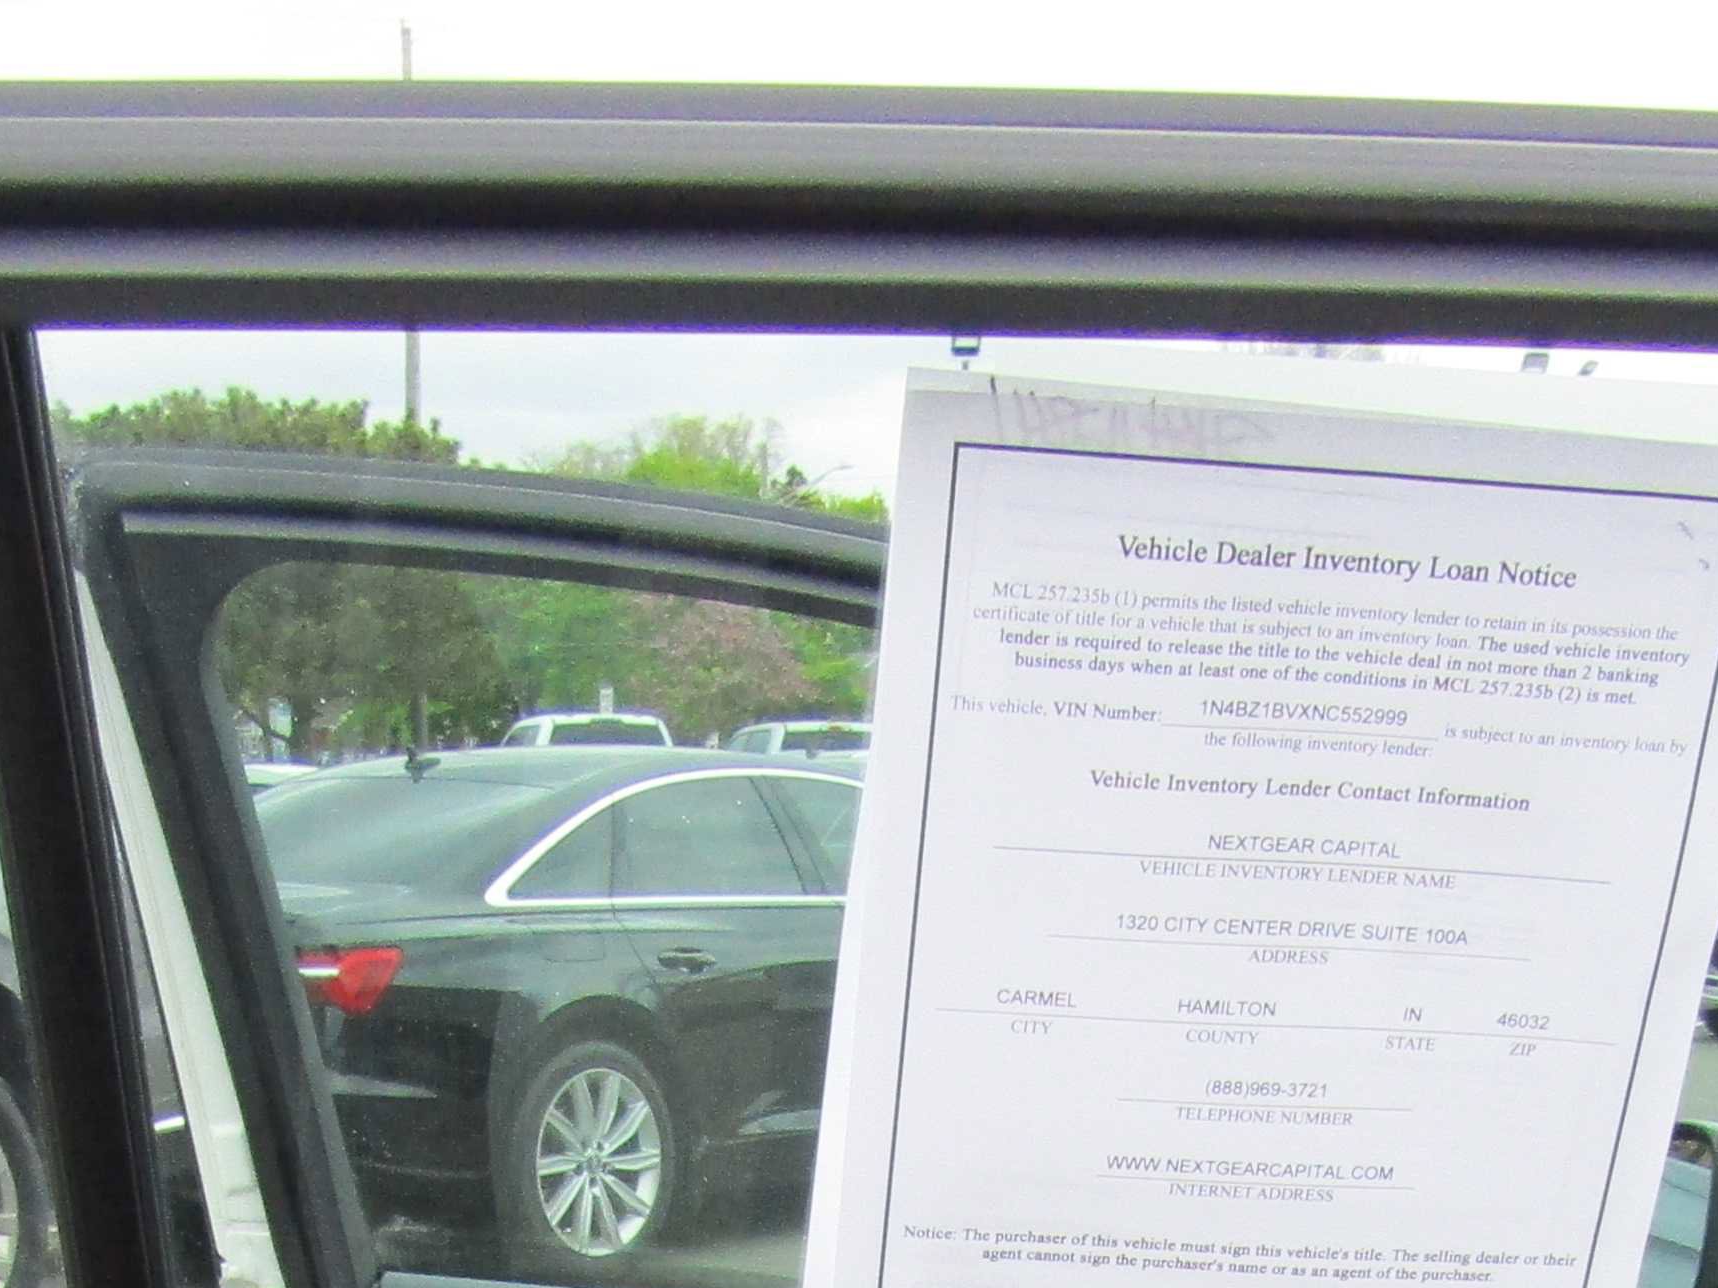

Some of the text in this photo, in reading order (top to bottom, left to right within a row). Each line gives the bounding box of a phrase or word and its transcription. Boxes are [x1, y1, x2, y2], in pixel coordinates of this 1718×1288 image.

[1119, 535, 1577, 588] Vehicle Dealer Inventory Loan Notice
[992, 582, 1034, 599] MCL
[1114, 590, 1139, 609] (1)
[1141, 594, 1199, 610] permits
[1203, 595, 1227, 611] the
[1231, 597, 1273, 614] listed
[1274, 601, 1332, 617] vehicle
[1334, 603, 1409, 626] inventory
[1411, 608, 1461, 626] lender
[1464, 614, 1480, 627] to
[1482, 615, 1528, 631] retain
[1530, 617, 1547, 632] in
[1549, 618, 1568, 634] its
[1571, 624, 1651, 640] possession
[1655, 627, 1679, 643] the
[973, 606, 1051, 623] certificate
[1054, 609, 1072, 624] of
[1075, 610, 1105, 626] title
[1110, 612, 1133, 627] for
[1136, 617, 1145, 628] a
[1151, 615, 1204, 632] vehicle
[1209, 618, 1241, 634] that
[1241, 619, 1256, 635] is
[1258, 622, 1312, 638] subject
[1317, 626, 1333, 640] to
[1335, 630, 1355, 641] an
[1357, 627, 1432, 650] inventory
[1475, 635, 1508, 651] The
[1513, 639, 1551, 654] used
[1553, 641, 1611, 659] vehicle
[1615, 645, 1690, 668] inventory
[999, 629, 1659, 689] lender is required to release the title to the vehicle deal in not more than 2 banking
[1015, 652, 1083, 670] business
[1088, 655, 1125, 675] days
[1130, 658, 1173, 674] when
[1178, 663, 1193, 675] at
[1198, 661, 1235, 678] least
[1239, 668, 1269, 680] one
[1273, 666, 1293, 681] of
[1295, 667, 1319, 683] the
[1323, 670, 1407, 688] conditions
[1411, 674, 1428, 690] in
[1432, 676, 1474, 693] MCL
[1557, 685, 1582, 704] (2)
[1586, 687, 1600, 703] is
[951, 696, 983, 712] This
[1053, 701, 1088, 717] VIN
[1202, 700, 1408, 726] 1N4BZ1BVXNC552999
[1204, 730, 1227, 746] the
[1232, 731, 1303, 753] following
[1307, 735, 1379, 757] inventory
[1091, 770, 1530, 811] Vehicle Inventory Lender Contact Information
[1208, 835, 1400, 858] NEXTGEAR CAPITAL
[1140, 861, 1456, 890] VEHICLE INVENTORY LENDER NAME
[1118, 915, 1468, 945] 1320 CITY CENTER DRIVE SUITE 100A
[1248, 948, 1329, 965] ADDRESS
[997, 989, 1076, 1009] CARMEL
[1178, 999, 1277, 1017] HAMILTON
[1010, 1018, 1053, 1034] CITY
[1403, 1008, 1422, 1022] IN
[1496, 1012, 1550, 1031] 46032
[1185, 1028, 1259, 1044] COUNTY
[1385, 1035, 1436, 1052] STATE
[1509, 1041, 1537, 1057] ZIP
[1205, 1079, 1327, 1098] (888)969-3721
[1177, 1106, 1353, 1126] TELEPHONE NUMBER
[1169, 1182, 1333, 1202] INTERNET ADDRESS
[963, 1228, 990, 1241] The
[994, 1232, 1067, 1245] purchaser
[1071, 1235, 1089, 1247] of
[1090, 1235, 1118, 1248] this
[1123, 1238, 1176, 1251] vehicle
[1179, 1243, 1216, 1253] must
[1220, 1242, 1251, 1258] sign
[1255, 1243, 1282, 1256] this
[1287, 1245, 1349, 1259] vehicle's
[1392, 1249, 1419, 1261] The
[1423, 1251, 1472, 1267] selling
[1475, 1252, 1520, 1265] dealer
[1523, 1258, 1539, 1266] or
[1543, 1254, 1577, 1267] their
[982, 1248, 1023, 1263] agent
[1026, 1251, 1075, 1264] cannot
[1079, 1250, 1111, 1269] sign
[1115, 1252, 1138, 1268] the
[1142, 1255, 1224, 1272] purchaser's
[1228, 1262, 1267, 1274] name
[1271, 1264, 1288, 1275] or
[1291, 1265, 1307, 1276] as
[1310, 1266, 1328, 1277] an
[1332, 1266, 1372, 1281] agent
[1375, 1265, 1395, 1280] of
[1395, 1265, 1417, 1280] the
